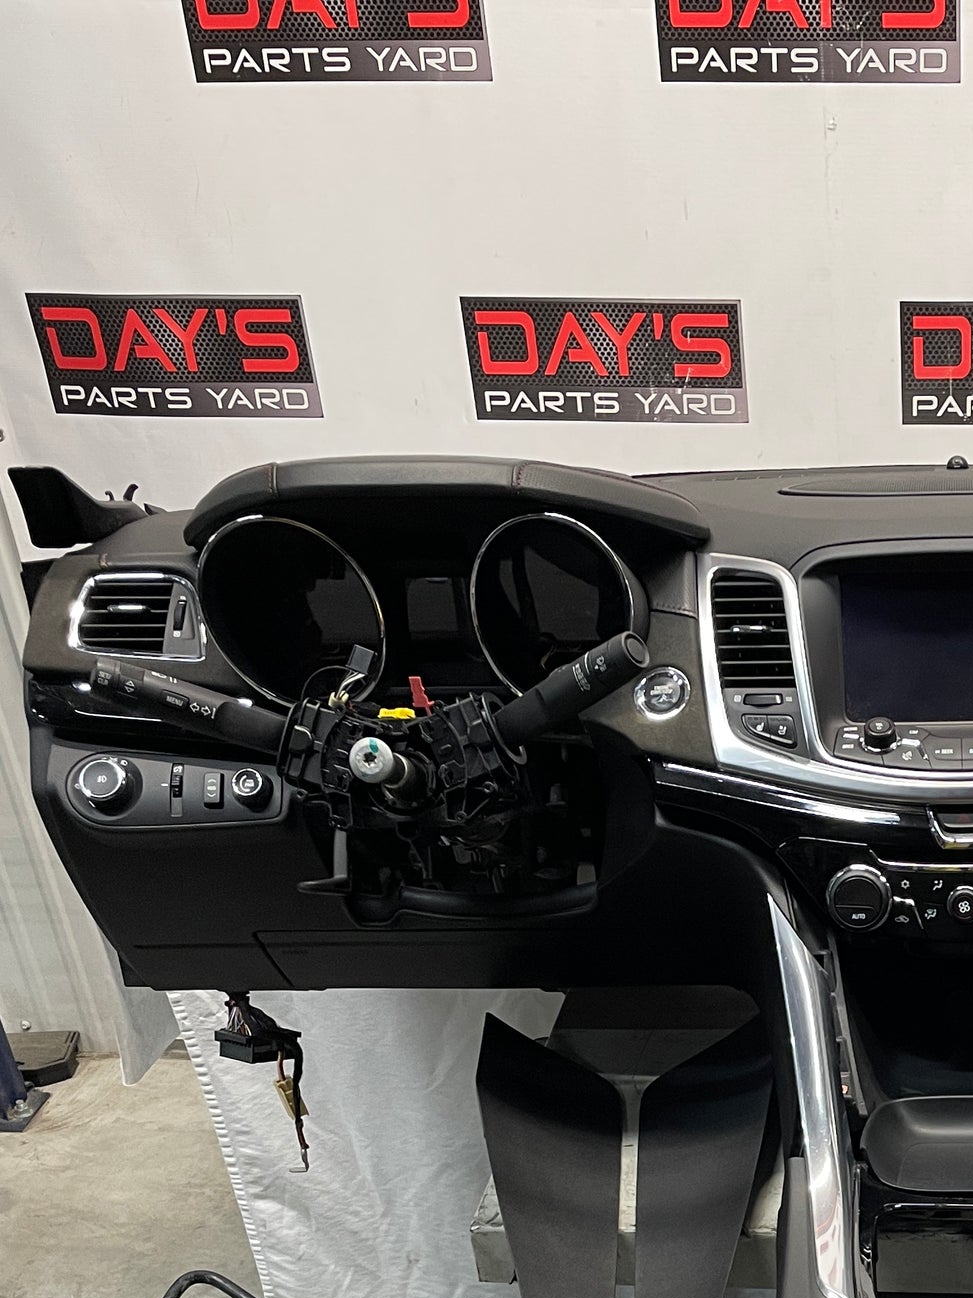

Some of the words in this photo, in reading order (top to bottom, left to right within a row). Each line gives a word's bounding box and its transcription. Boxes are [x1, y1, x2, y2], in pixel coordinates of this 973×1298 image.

[203, 47, 352, 74] PARTS
[366, 46, 478, 73] YARD
[670, 47, 819, 74] PARTS
[839, 47, 949, 74] YARD
[41, 306, 300, 373] DAY'S
[474, 310, 732, 378] DAY'S
[60, 384, 193, 409] PARTS
[205, 387, 310, 411] YARD
[484, 389, 620, 415] PARTS
[634, 391, 737, 416] YARD
